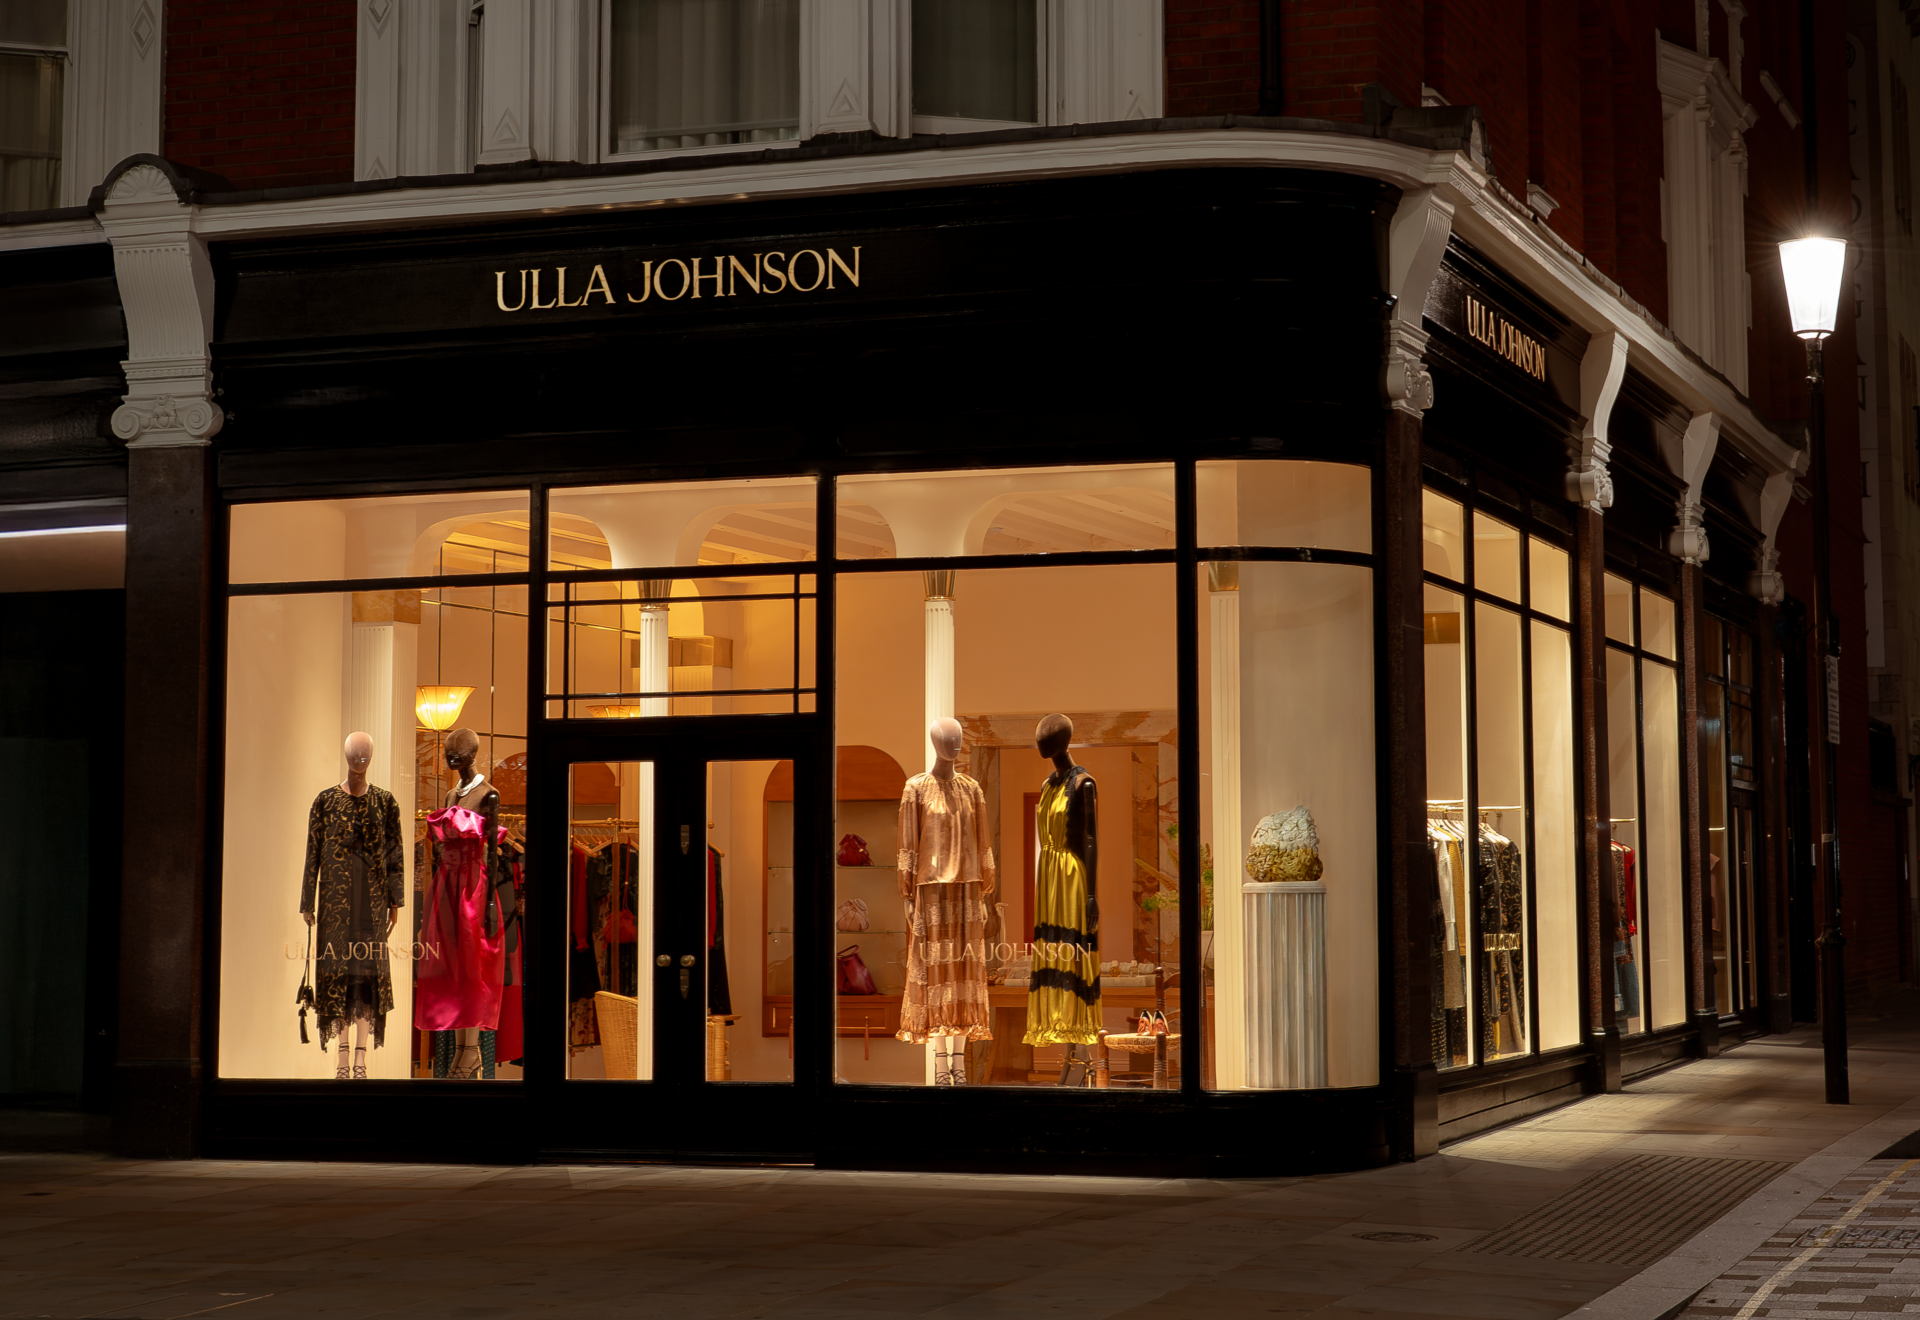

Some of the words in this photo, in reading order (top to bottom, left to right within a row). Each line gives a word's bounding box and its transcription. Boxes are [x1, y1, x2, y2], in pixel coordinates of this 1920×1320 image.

[495, 264, 616, 312] ULLA
[627, 246, 862, 304] JOHNSON
[1467, 295, 1497, 351] ULLA
[1498, 318, 1545, 382] JOHNSON
[285, 942, 337, 960] ULLA
[341, 942, 440, 960] JOHNSON
[918, 942, 978, 962] ULLA
[984, 942, 1092, 962] JOHNSON
